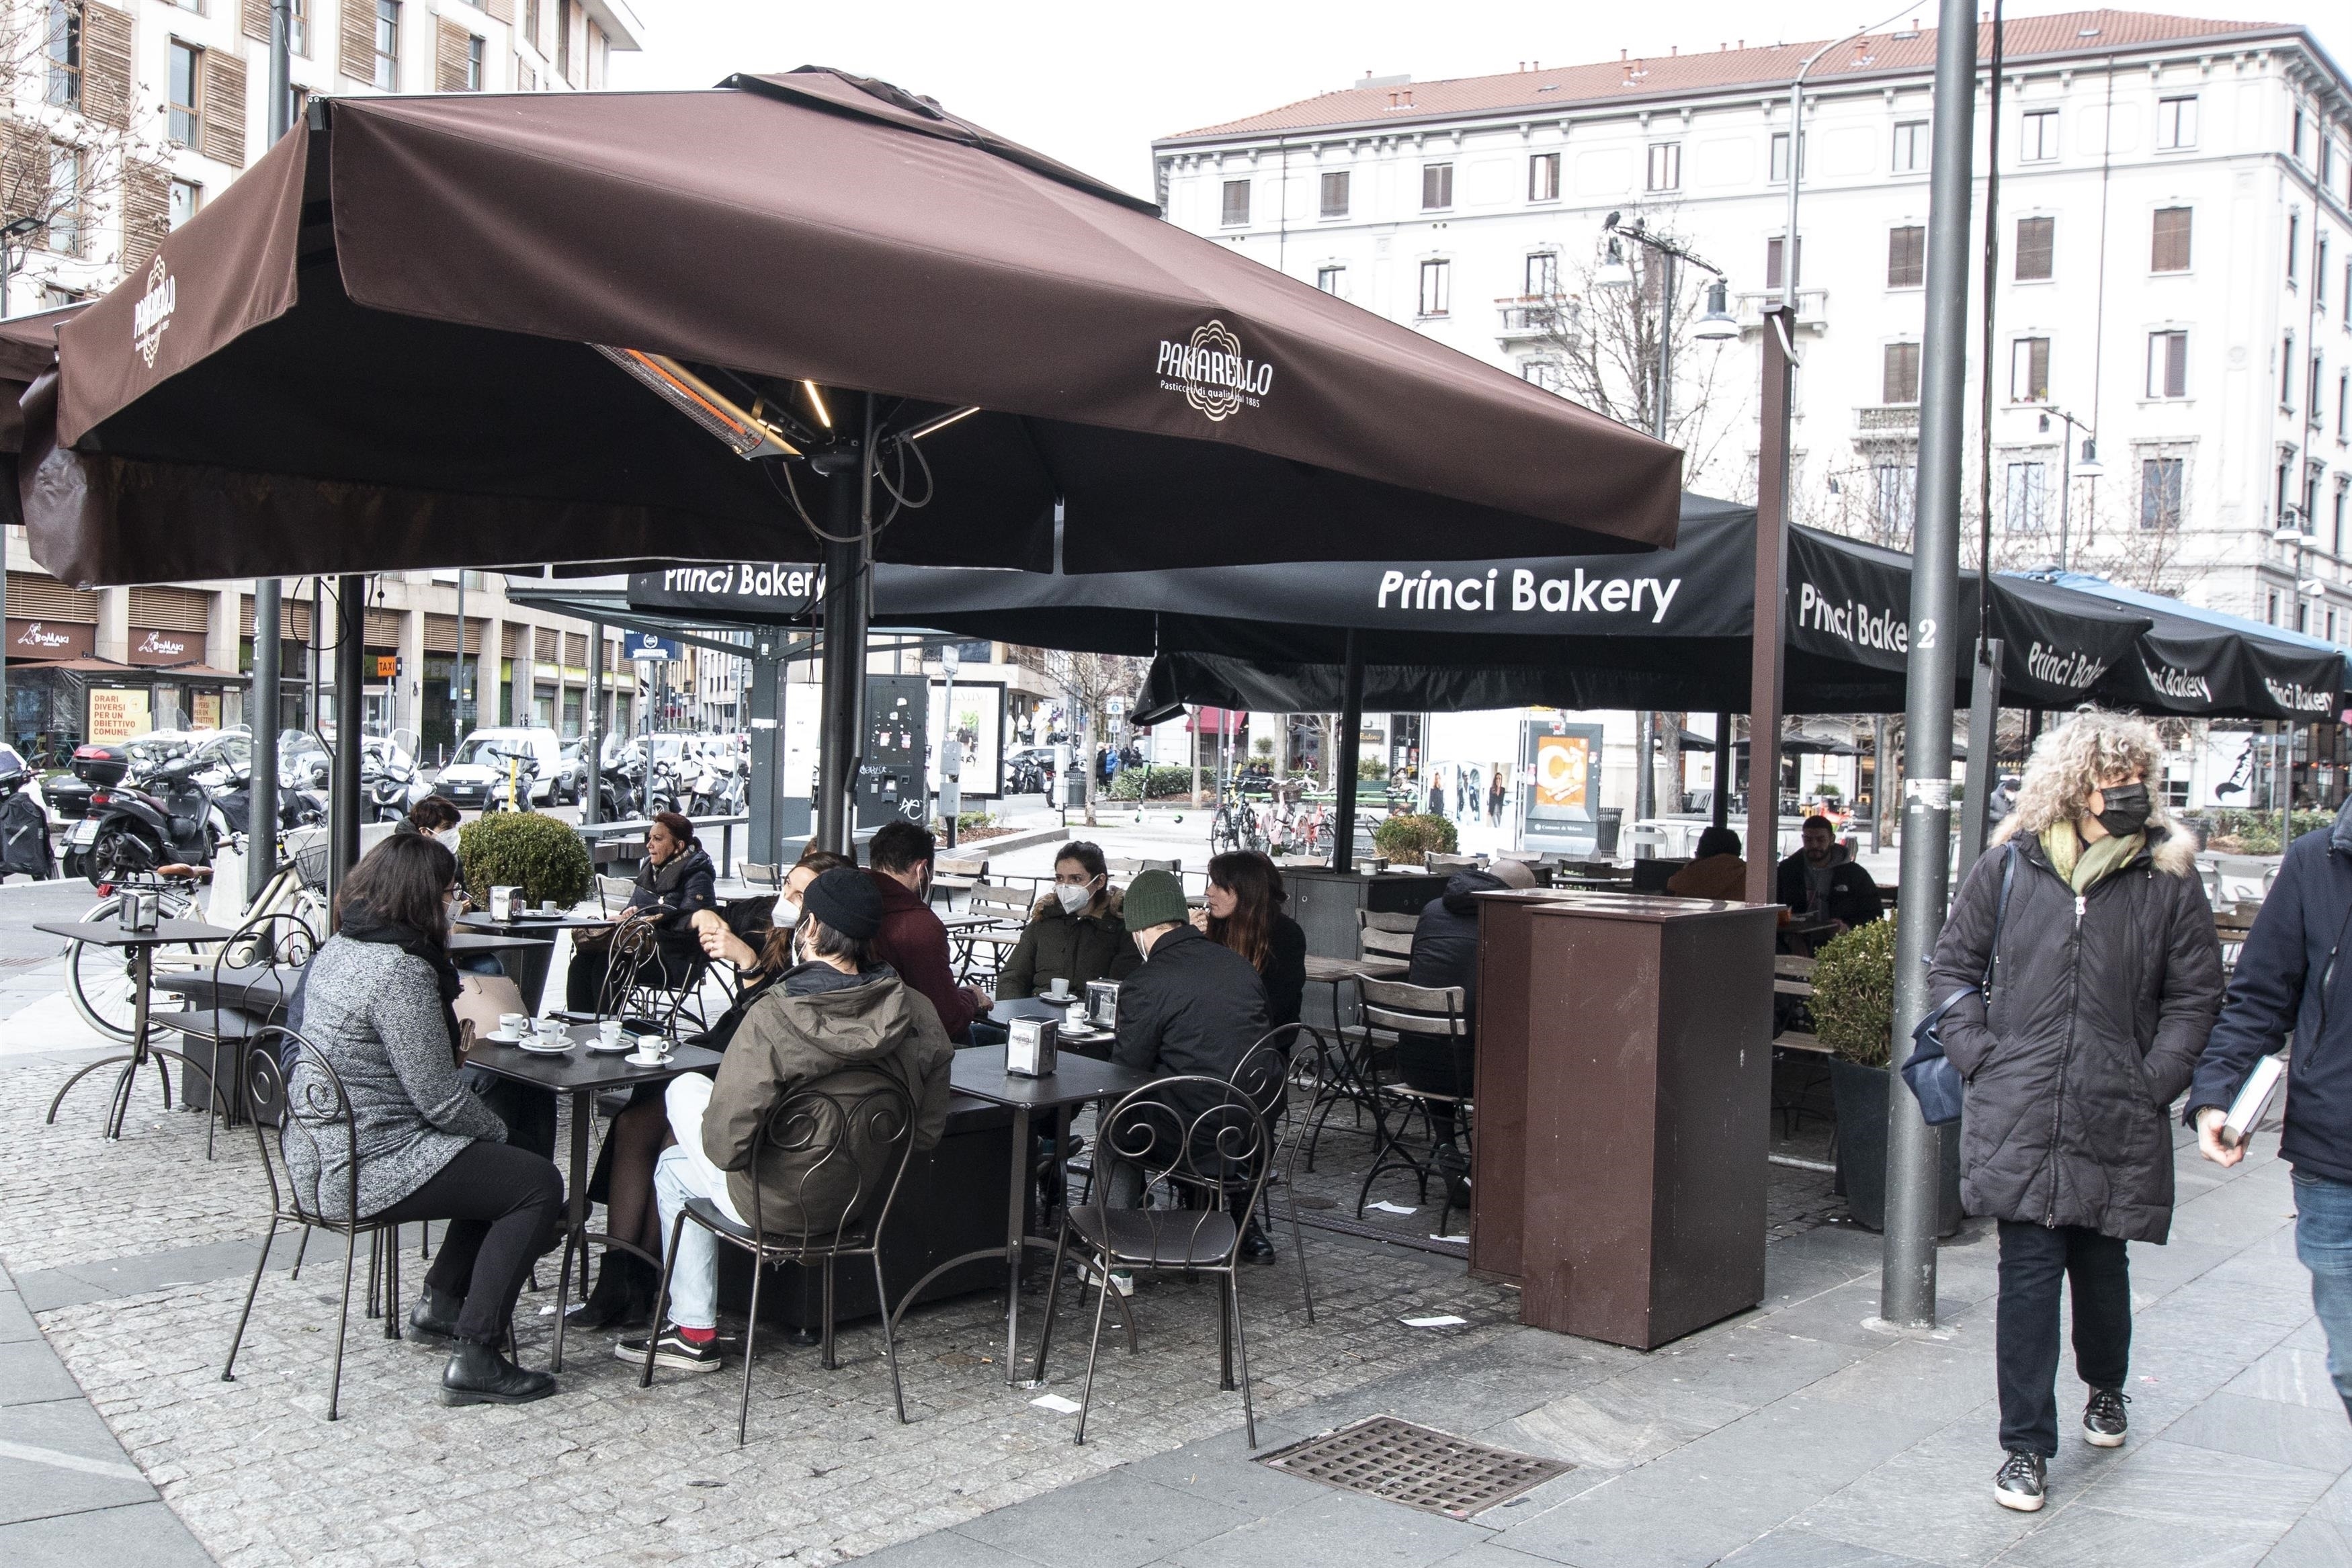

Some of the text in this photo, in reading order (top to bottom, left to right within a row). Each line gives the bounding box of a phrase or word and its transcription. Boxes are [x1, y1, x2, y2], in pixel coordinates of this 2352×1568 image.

[1156, 340, 1273, 396] PANARELLO
[1198, 387, 1206, 396] di
[1246, 396, 1260, 408] 1885
[738, 564, 827, 605] Bakery
[1378, 568, 1681, 623] Princi Bakery
[1857, 604, 1910, 653] Bake
[1917, 619, 1937, 648] 2
[379, 662, 395, 671] TAXI
[2028, 642, 2076, 685] Princi
[2166, 668, 2212, 703] Bakery
